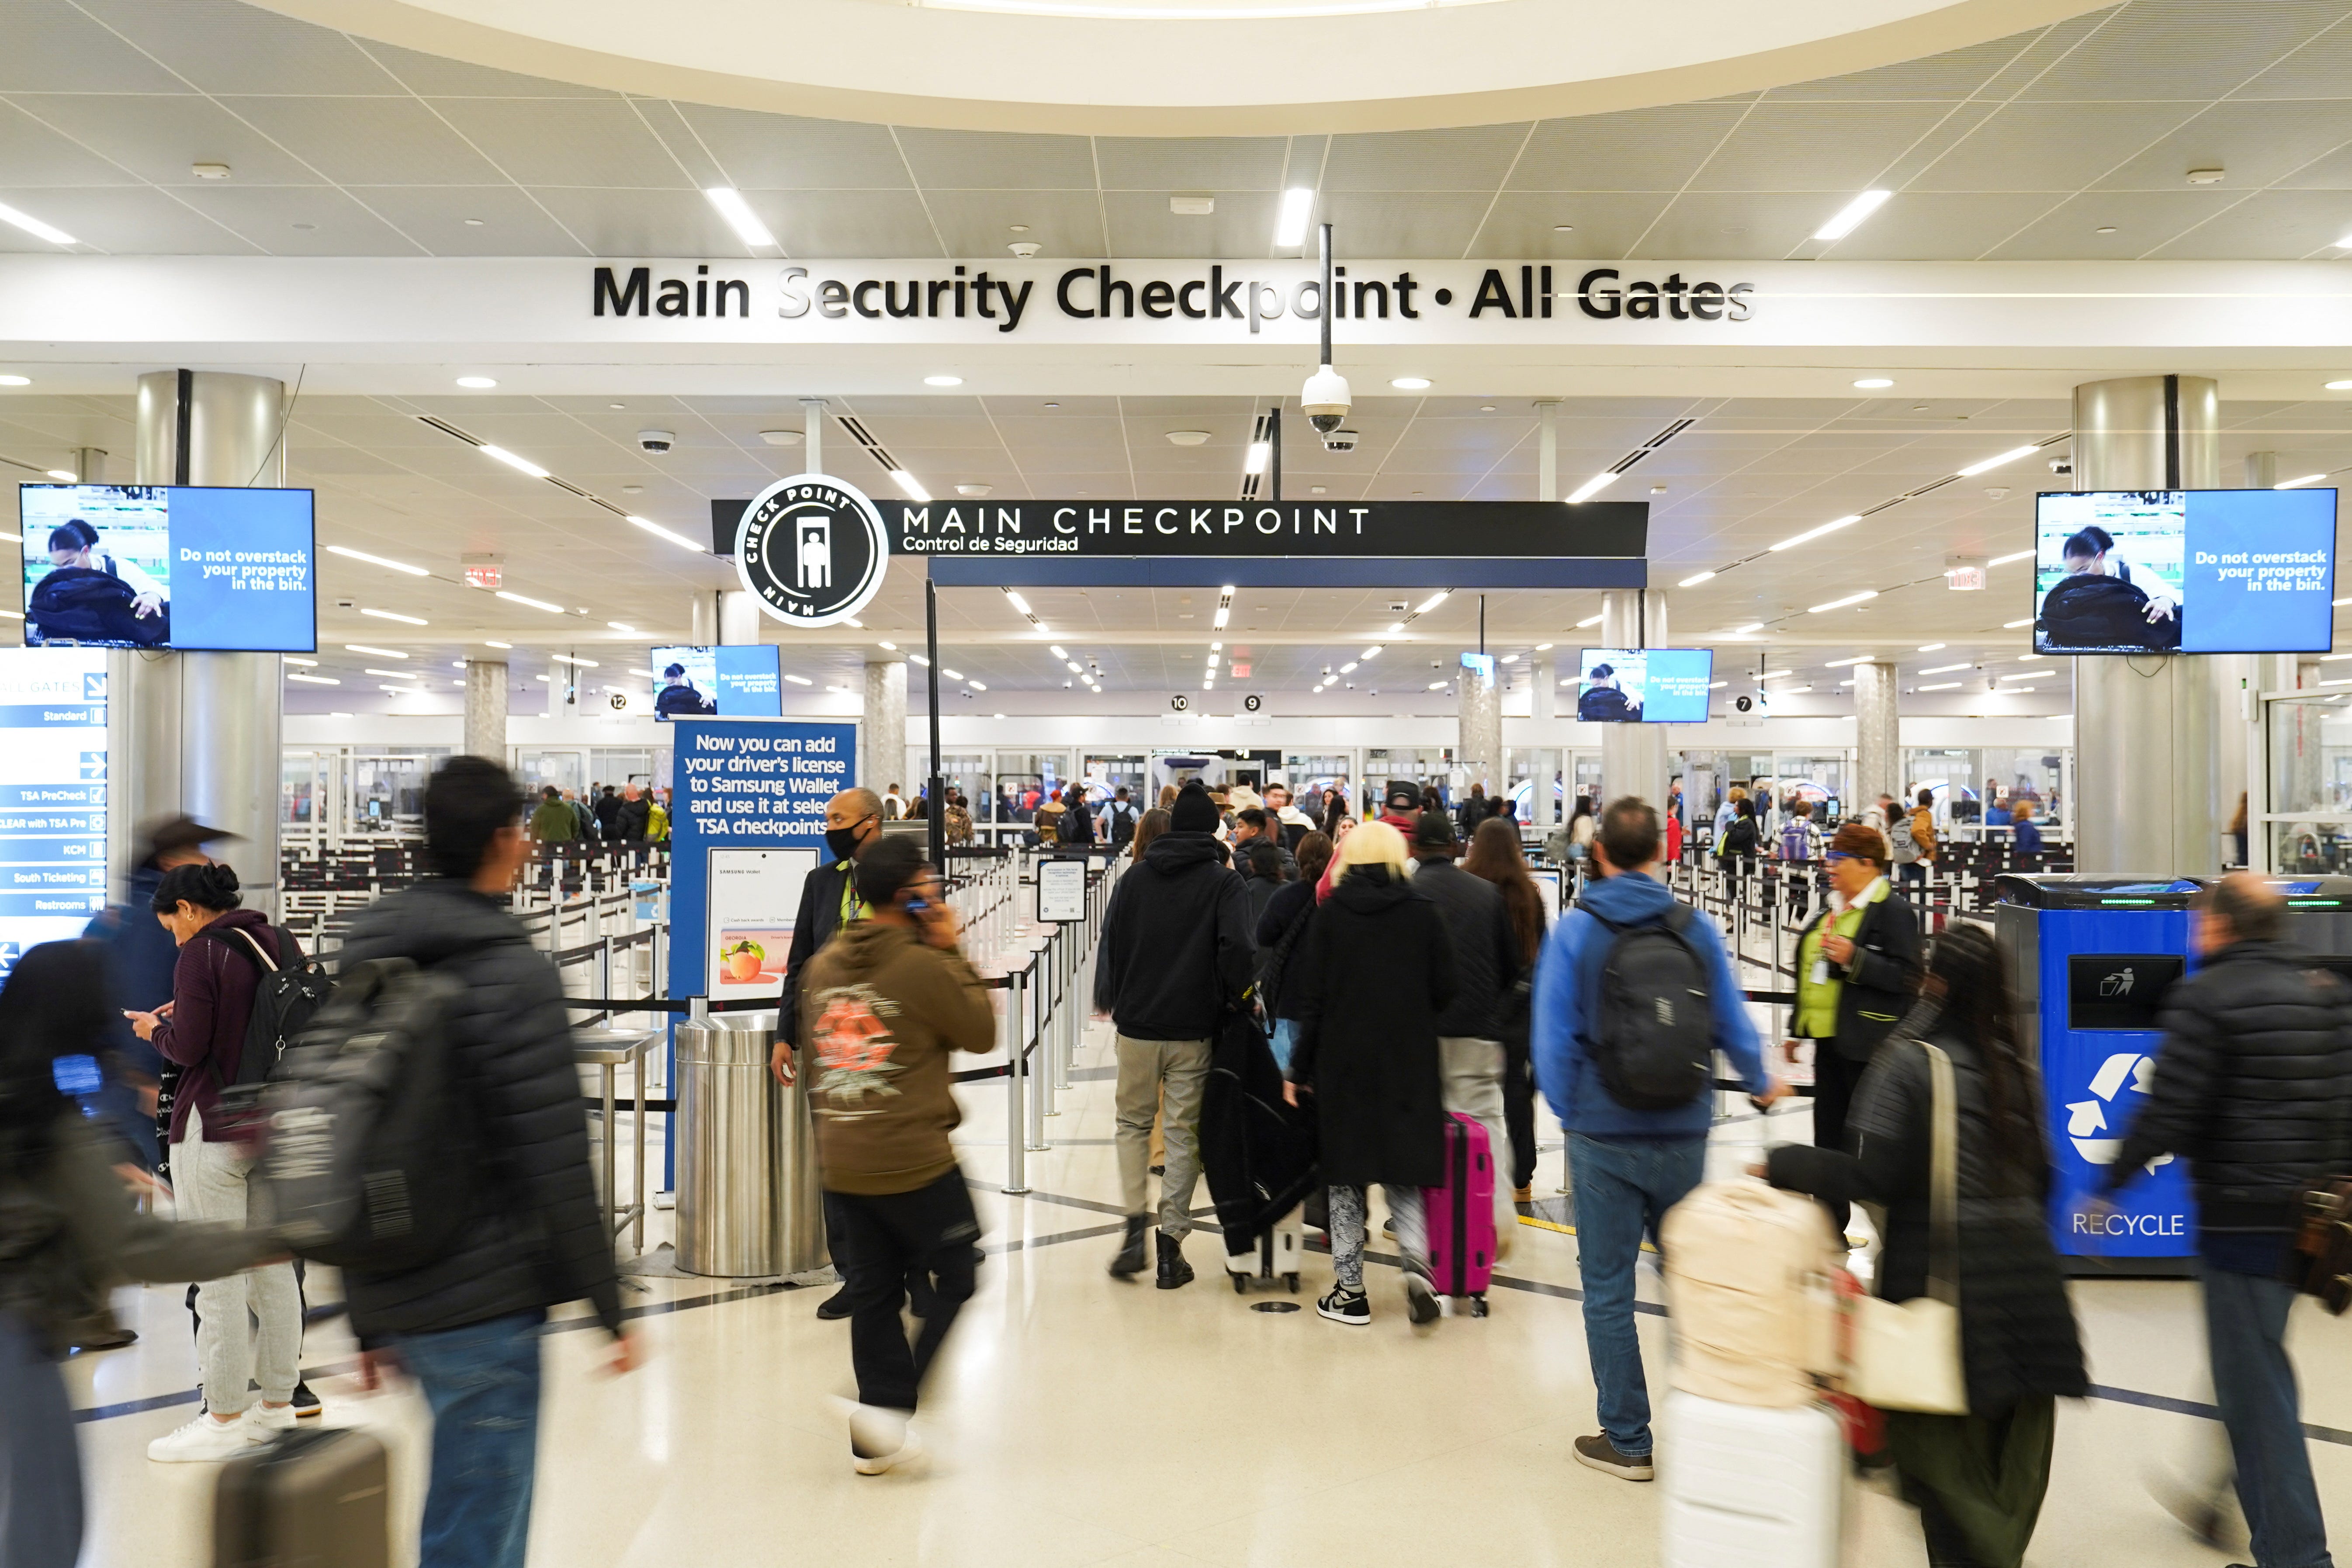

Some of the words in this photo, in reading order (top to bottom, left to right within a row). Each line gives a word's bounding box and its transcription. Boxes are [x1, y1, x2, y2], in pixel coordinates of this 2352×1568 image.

[593, 265, 750, 318] Main
[778, 265, 1033, 332] Security
[1057, 265, 1419, 333] Checkpoint
[1469, 265, 1552, 319] All
[1578, 268, 1756, 320] Gates
[786, 486, 850, 509] POINT
[904, 507, 1021, 533] MAIN
[1053, 508, 1369, 534] CHECKPOINT
[746, 498, 779, 564] CHECK
[903, 536, 964, 551] Control
[969, 536, 990, 551] de
[994, 537, 1078, 554] Seguridad
[180, 548, 201, 561] Do
[206, 550, 231, 562] not
[235, 550, 306, 563] overstack
[2196, 551, 2217, 564] Do
[2222, 552, 2248, 564] not
[2252, 549, 2327, 564] overstack
[203, 565, 238, 579] your
[242, 565, 307, 580] property
[2218, 567, 2254, 582] your
[2258, 565, 2327, 581] property
[232, 576, 246, 590] in
[250, 576, 274, 590] the
[279, 577, 306, 591] bin.
[2247, 578, 2262, 591] in
[2266, 578, 2292, 591] the
[2296, 577, 2325, 591] bin.
[763, 586, 814, 616] MAIN
[31, 682, 80, 692] GATES
[613, 696, 624, 708] 12
[1173, 697, 1187, 709] 10
[1248, 697, 1257, 709] 9
[1740, 699, 1747, 710] 7
[44, 711, 87, 721] Standard
[696, 734, 735, 751] Now
[738, 738, 770, 754] you
[773, 738, 801, 752] can
[805, 737, 836, 753] add
[684, 757, 724, 775] your
[792, 756, 845, 774] license
[690, 776, 708, 793] to
[711, 776, 786, 796] Samsung
[789, 778, 839, 794] Wallet
[21, 791, 39, 801] TSA
[42, 790, 87, 801] PreCheck
[690, 797, 722, 814] and
[726, 800, 754, 814] use
[758, 797, 769, 814] it
[772, 798, 790, 814] at
[793, 798, 829, 814] selec
[28, 819, 47, 828] with
[49, 819, 69, 828] TSA
[70, 818, 87, 828] Pre
[696, 818, 730, 835] TSA
[733, 818, 828, 838] checkpoints
[63, 845, 86, 855] KCM
[14, 872, 41, 883] South
[42, 872, 86, 884] Ticketing
[35, 900, 86, 910] Restrooms
[2073, 1213, 2184, 1236] RECYCLE
